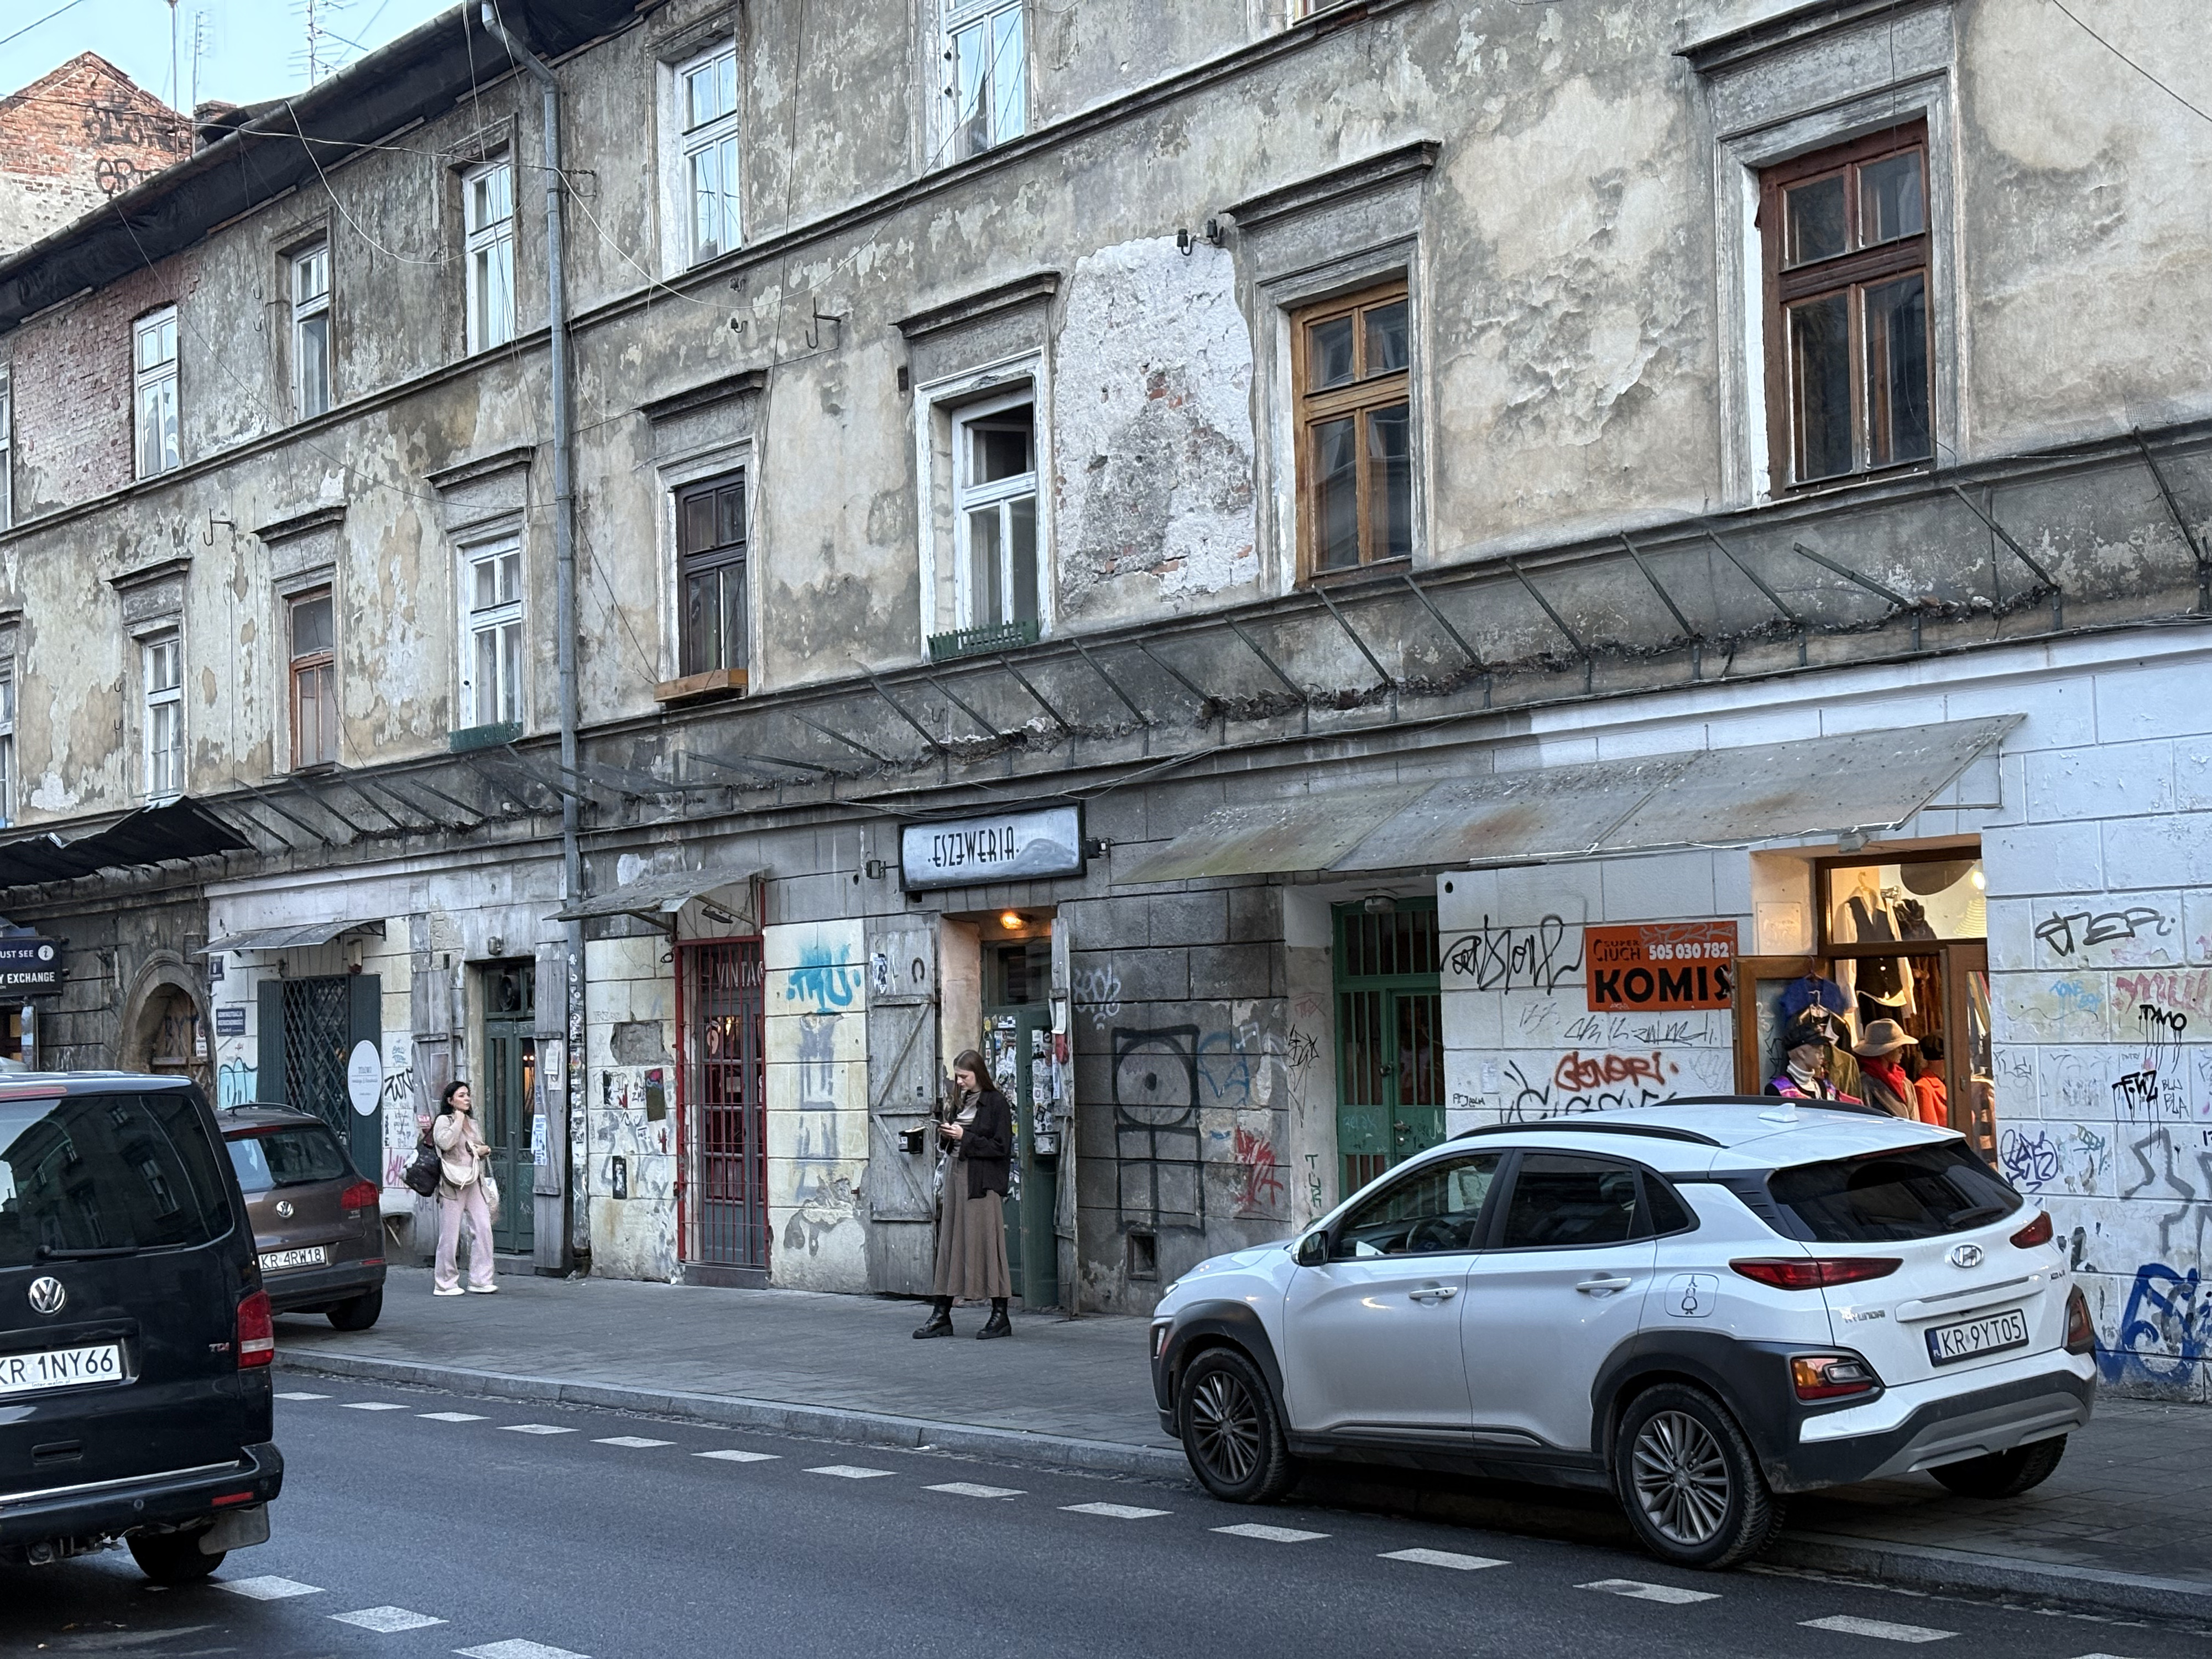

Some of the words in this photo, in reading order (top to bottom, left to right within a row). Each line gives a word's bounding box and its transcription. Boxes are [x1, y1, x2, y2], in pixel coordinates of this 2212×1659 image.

[18, 950, 34, 958] SEE
[1649, 943, 1673, 961] 505
[1676, 942, 1702, 959] 030
[1703, 942, 1730, 958] 782
[7, 972, 55, 984] EXCHANGE
[1594, 964, 1731, 1004] KOMIS
[260, 1254, 279, 1269] KR
[283, 1248, 321, 1265] 4RW18
[1942, 1329, 1967, 1356] KR
[1970, 1316, 2022, 1349] 9YT05
[37, 1348, 113, 1380] 1NY66
